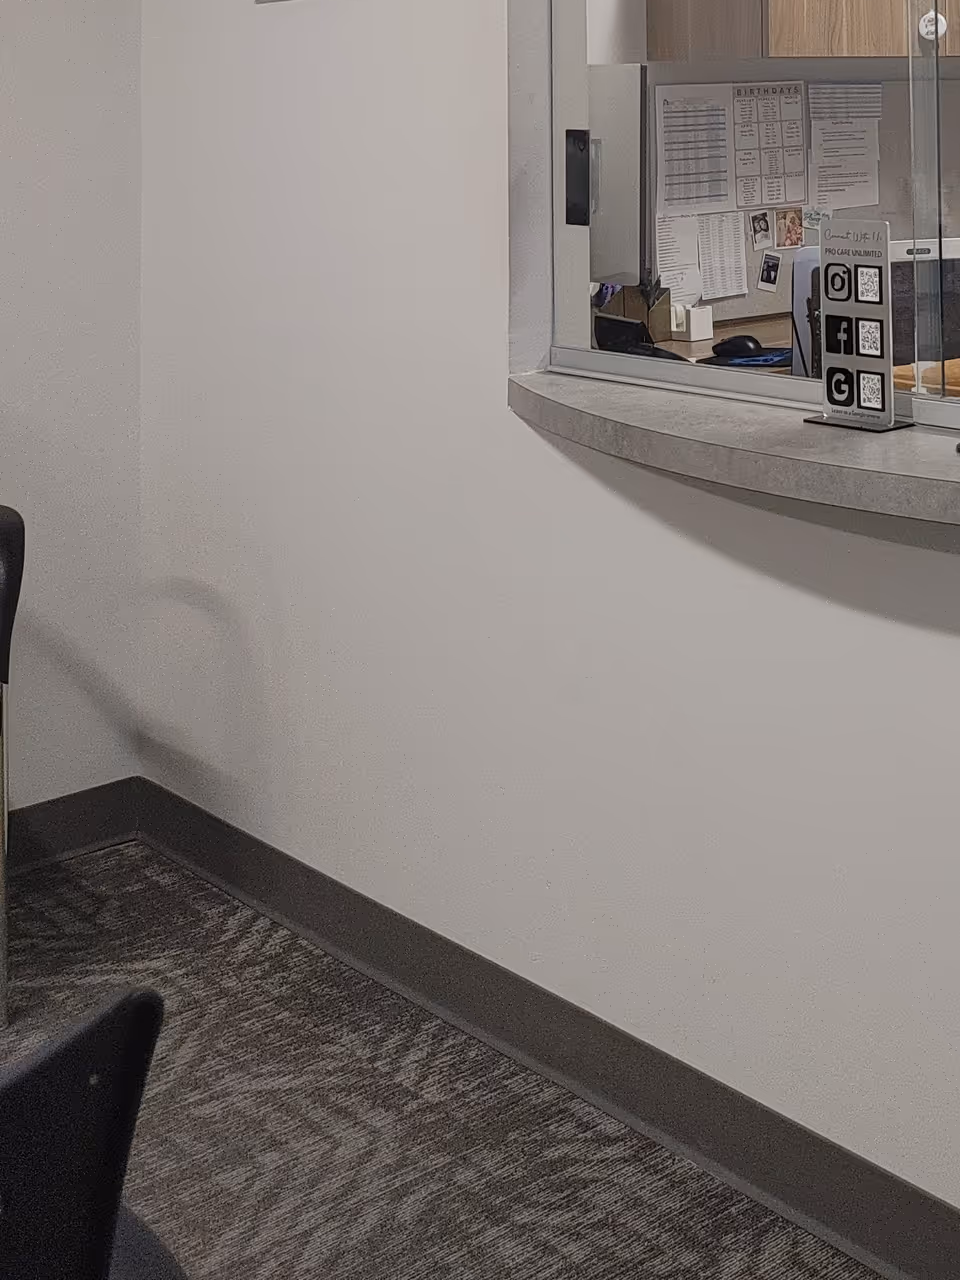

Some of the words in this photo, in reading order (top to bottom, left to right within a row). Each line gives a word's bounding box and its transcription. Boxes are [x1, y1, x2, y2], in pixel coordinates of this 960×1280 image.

[736, 86, 799, 96] BIRTHDAYS
[825, 247, 836, 256] PRO
[837, 248, 851, 257] CARE
[851, 249, 883, 259] UNLIMITED
